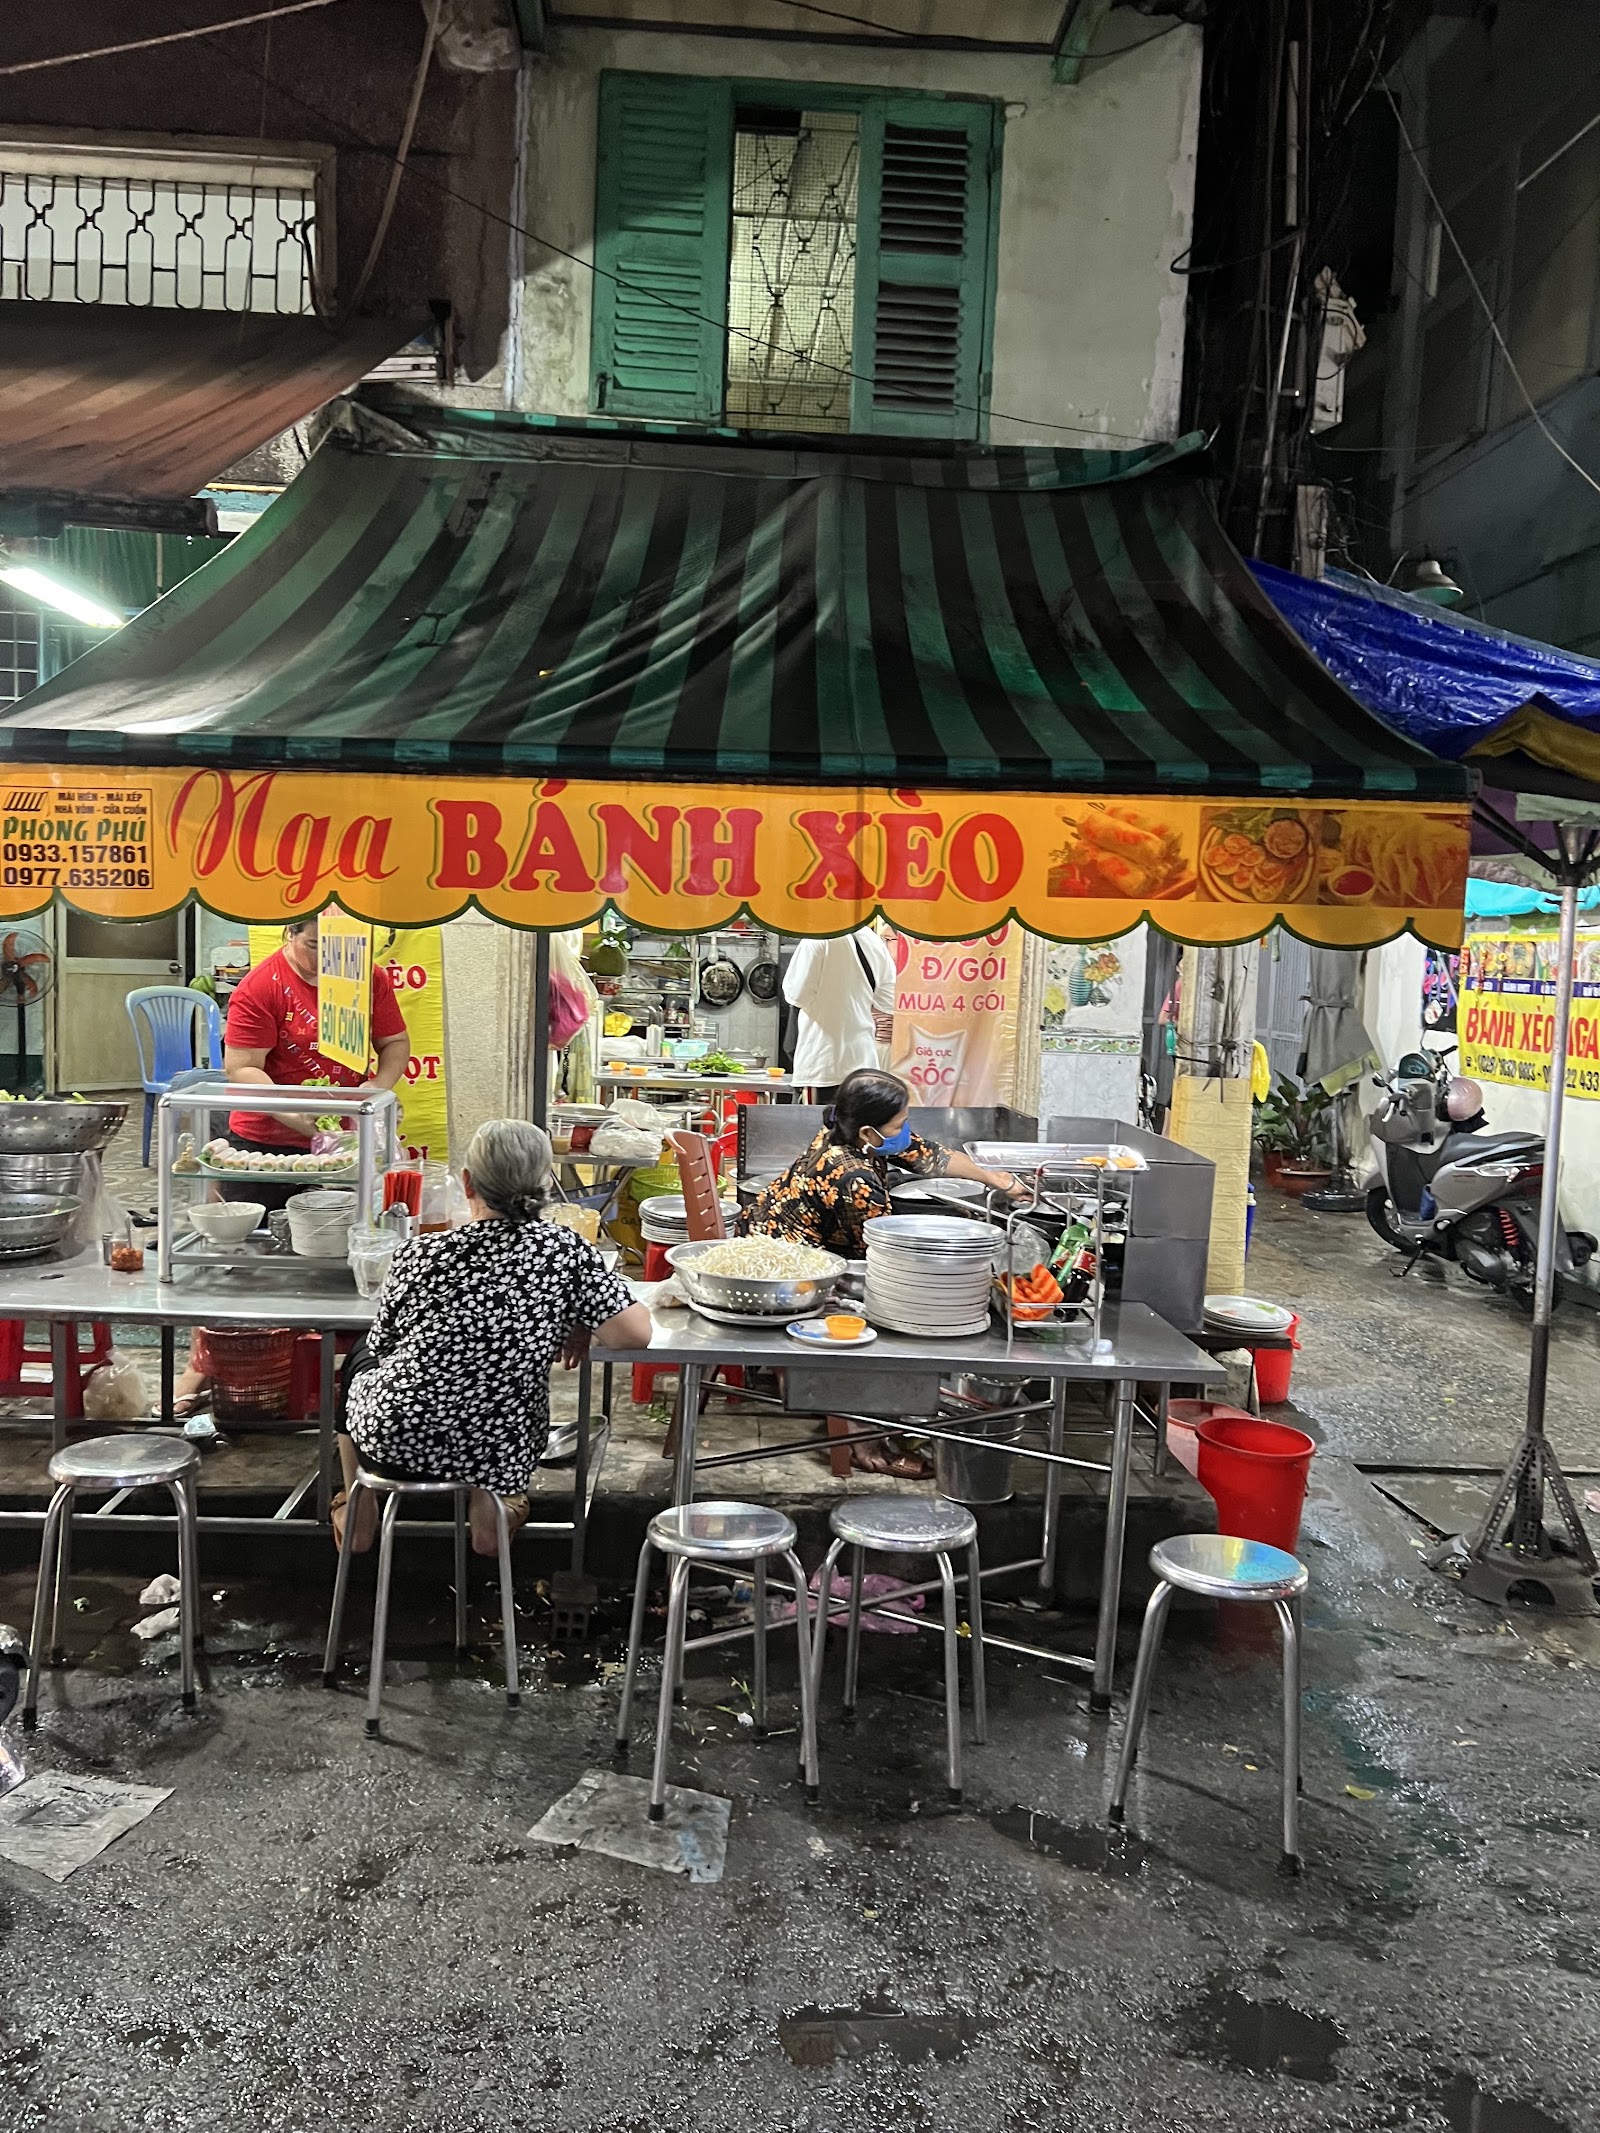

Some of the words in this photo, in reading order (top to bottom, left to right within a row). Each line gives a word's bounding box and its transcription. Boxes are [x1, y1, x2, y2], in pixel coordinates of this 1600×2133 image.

[3, 816, 90, 841] PHONG
[96, 816, 147, 842] PHÚ
[168, 768, 400, 904] Nga
[431, 778, 764, 896] BÁNH
[791, 788, 1025, 903] XÈO
[4, 843, 147, 864] 0933.157861
[4, 867, 150, 887] 0977.635206
[384, 959, 428, 990] ÈO
[921, 952, 1006, 982] Đ/GÓI
[898, 992, 946, 1012] MUA
[952, 995, 966, 1012] 4
[972, 990, 1005, 1012] GÓI
[1465, 1001, 1515, 1049] BÁNH
[1519, 1005, 1556, 1053] XÈO
[910, 1058, 955, 1086] SỐC
